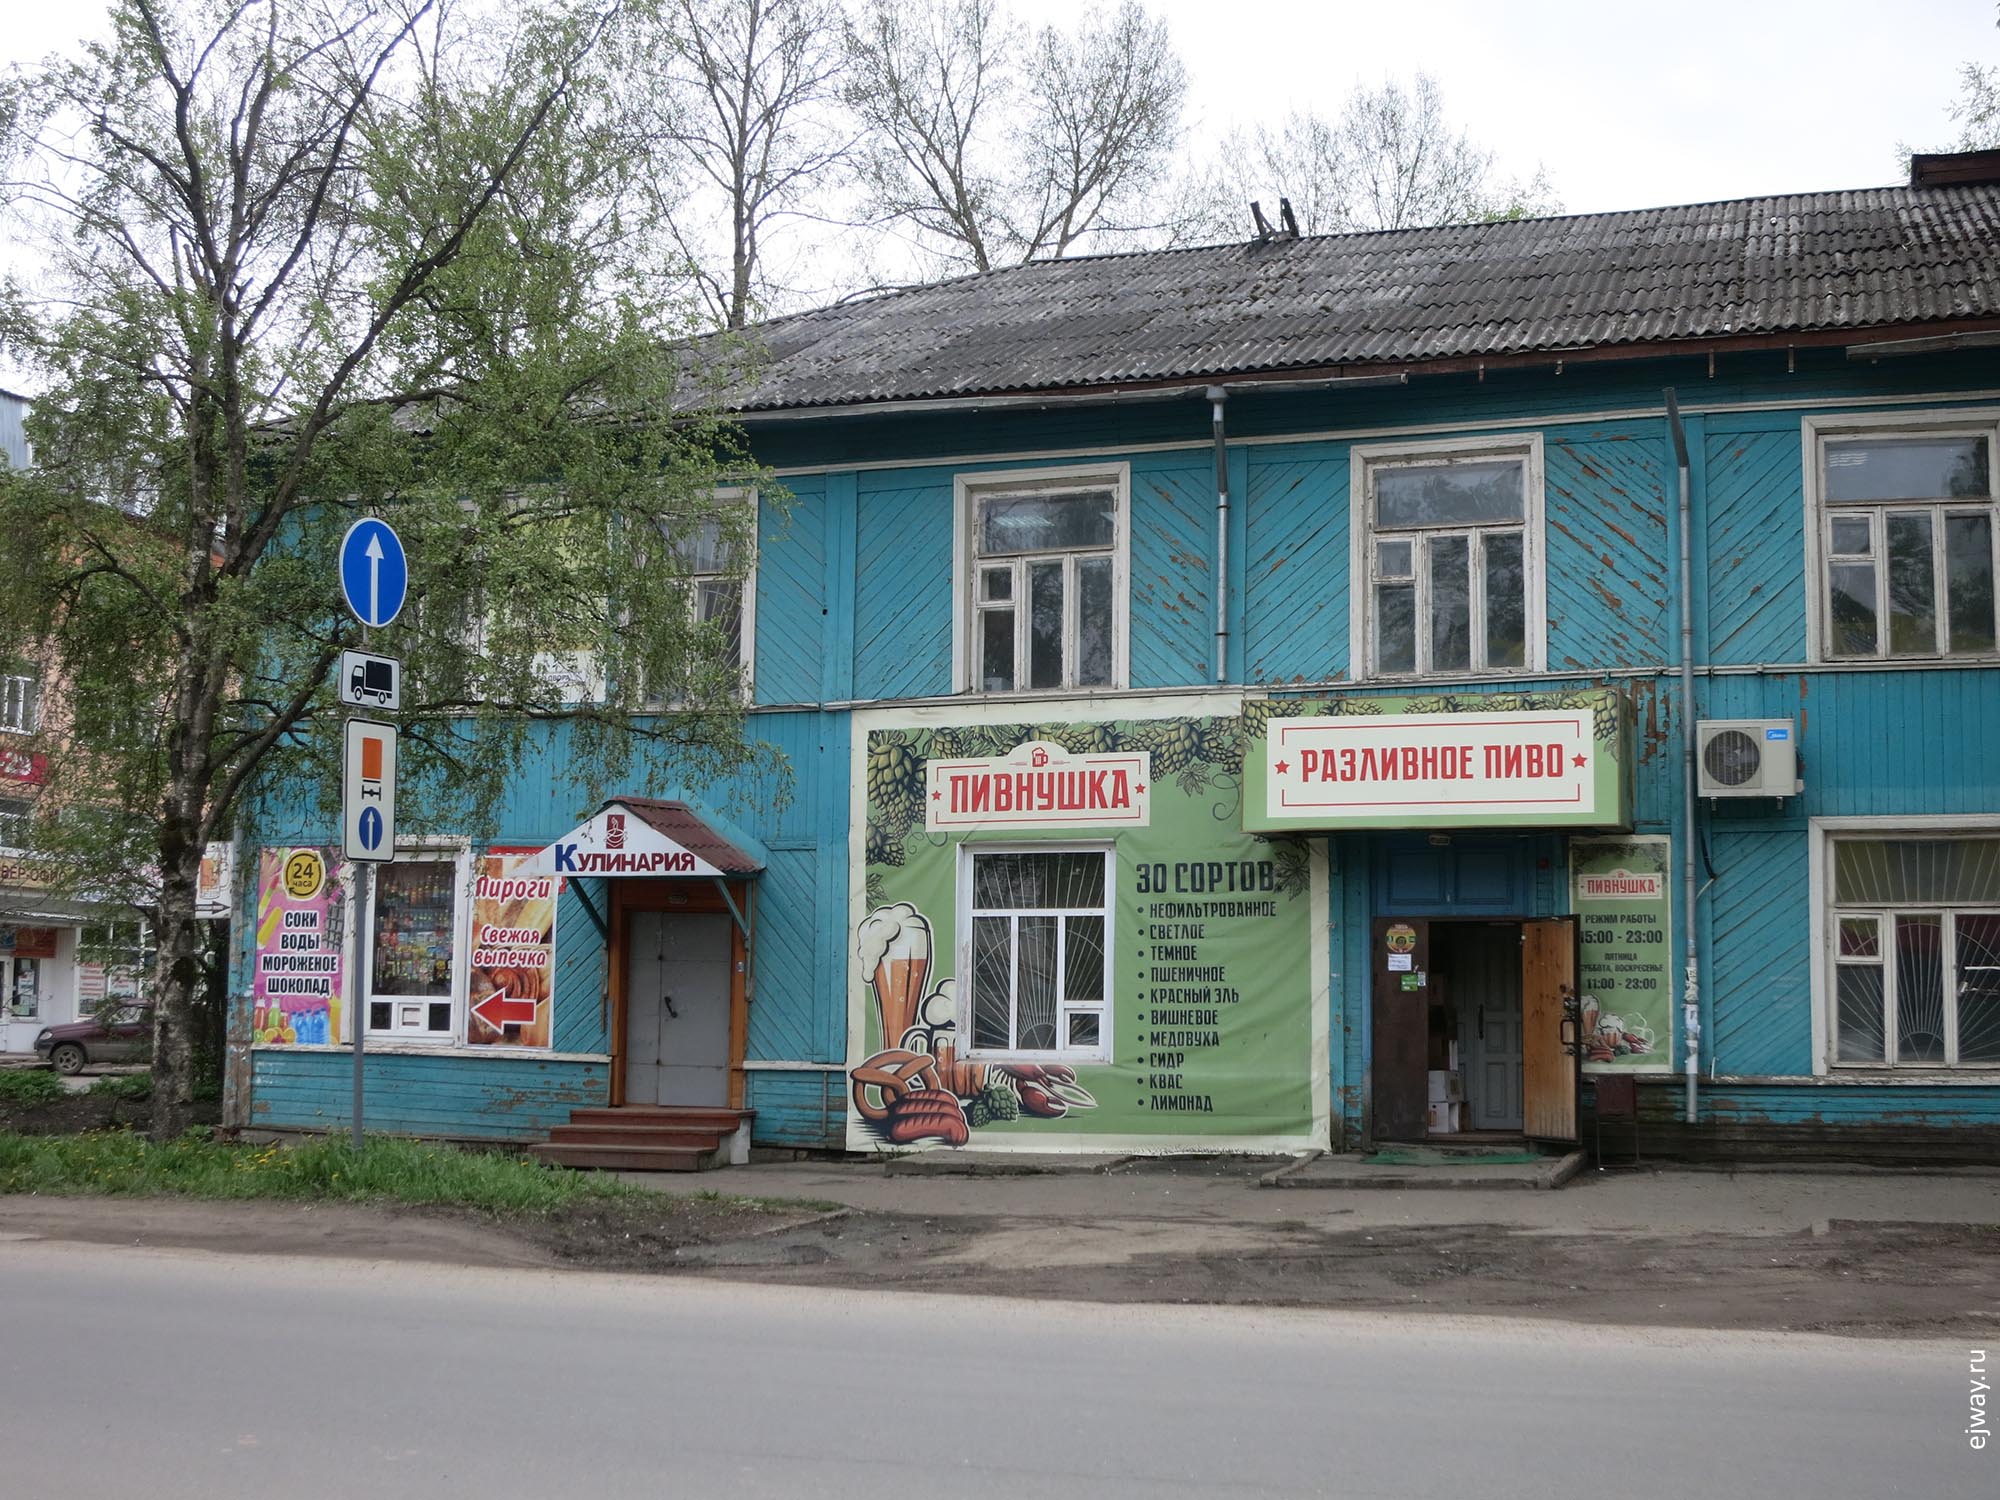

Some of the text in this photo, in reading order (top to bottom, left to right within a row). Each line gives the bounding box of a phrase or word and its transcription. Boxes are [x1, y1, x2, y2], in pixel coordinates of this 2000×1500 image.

[1300, 744, 1564, 782] РАЗЛИВНОЕ ПИВО
[950, 770, 1130, 813] ПИВНУШКА
[293, 863, 314, 879] 24
[1136, 861, 1274, 893] 30 СОРТОВ
[475, 876, 551, 903] Пироги
[1587, 879, 1655, 893] ПИВНУШКА
[1150, 901, 1277, 918] НЕФИЛЬТРОВАННОЕ
[285, 912, 318, 927] СОКИ
[1585, 914, 1657, 924] РЕЖИМ РАБОТЫ
[481, 926, 540, 944] Свежая
[1150, 924, 1205, 940] СВЕТЛОЕ
[1626, 930, 1663, 944] 23:00
[281, 934, 320, 951] ВОДЫ
[474, 950, 546, 965] выпечка
[1150, 945, 1197, 961] ТЕМНОЕ
[262, 956, 337, 972] МОРОЖЕНОЕ
[1151, 967, 1225, 982] ПШЕНИЧНОЕ
[267, 978, 331, 995] ШОКОЛАД
[1587, 978, 1615, 989] 11:00
[1625, 978, 1657, 989] 23:00
[1150, 986, 1240, 1004] КРАСНЫЙ ЭЛЬ
[1151, 1009, 1218, 1025] ВИШНЕВОЕ
[1150, 1031, 1220, 1047] МЕДОВУХА
[1150, 1053, 1184, 1069] СИДР
[1150, 1074, 1183, 1089] КВАС
[1151, 1095, 1213, 1112] ЛИМОНАД
